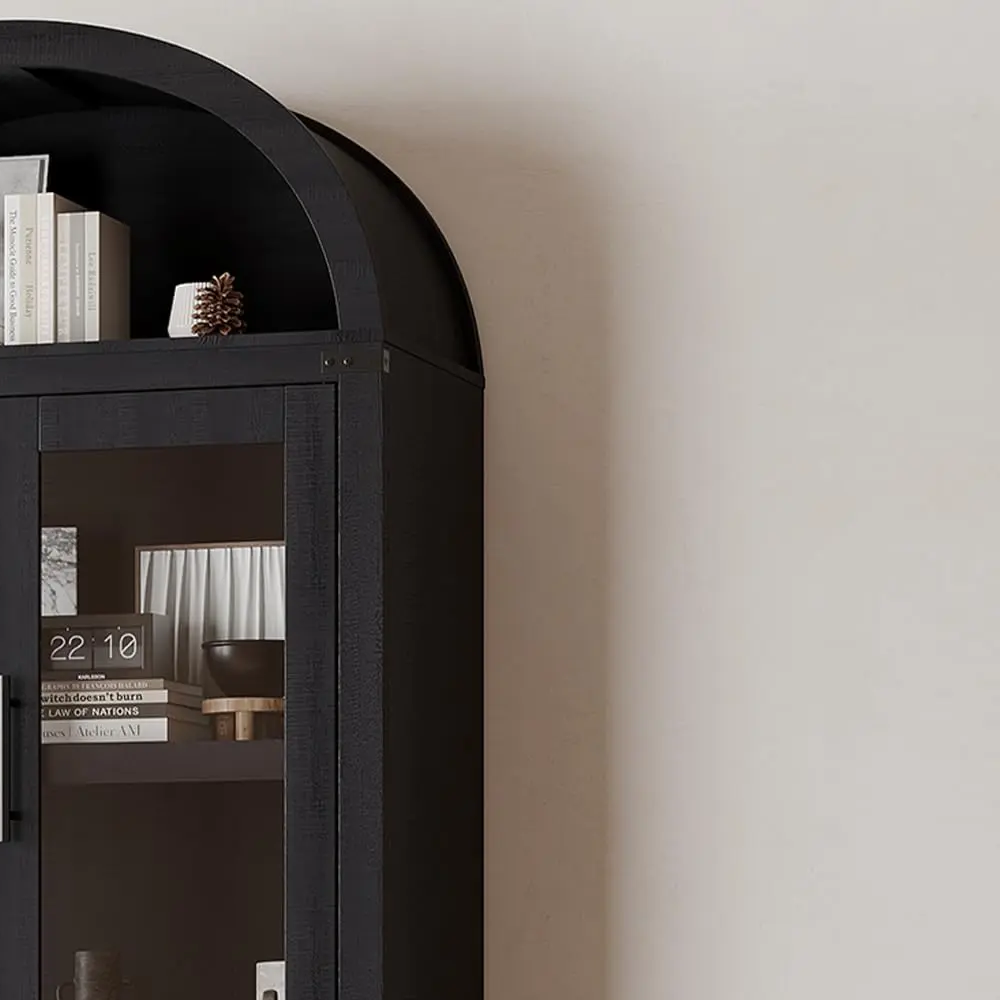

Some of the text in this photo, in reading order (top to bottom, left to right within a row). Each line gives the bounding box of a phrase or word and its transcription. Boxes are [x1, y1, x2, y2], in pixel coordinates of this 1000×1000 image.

[116, 691, 143, 701] burn
[48, 706, 140, 718] LAW OF NATIONS
[78, 725, 114, 738] Atelier
